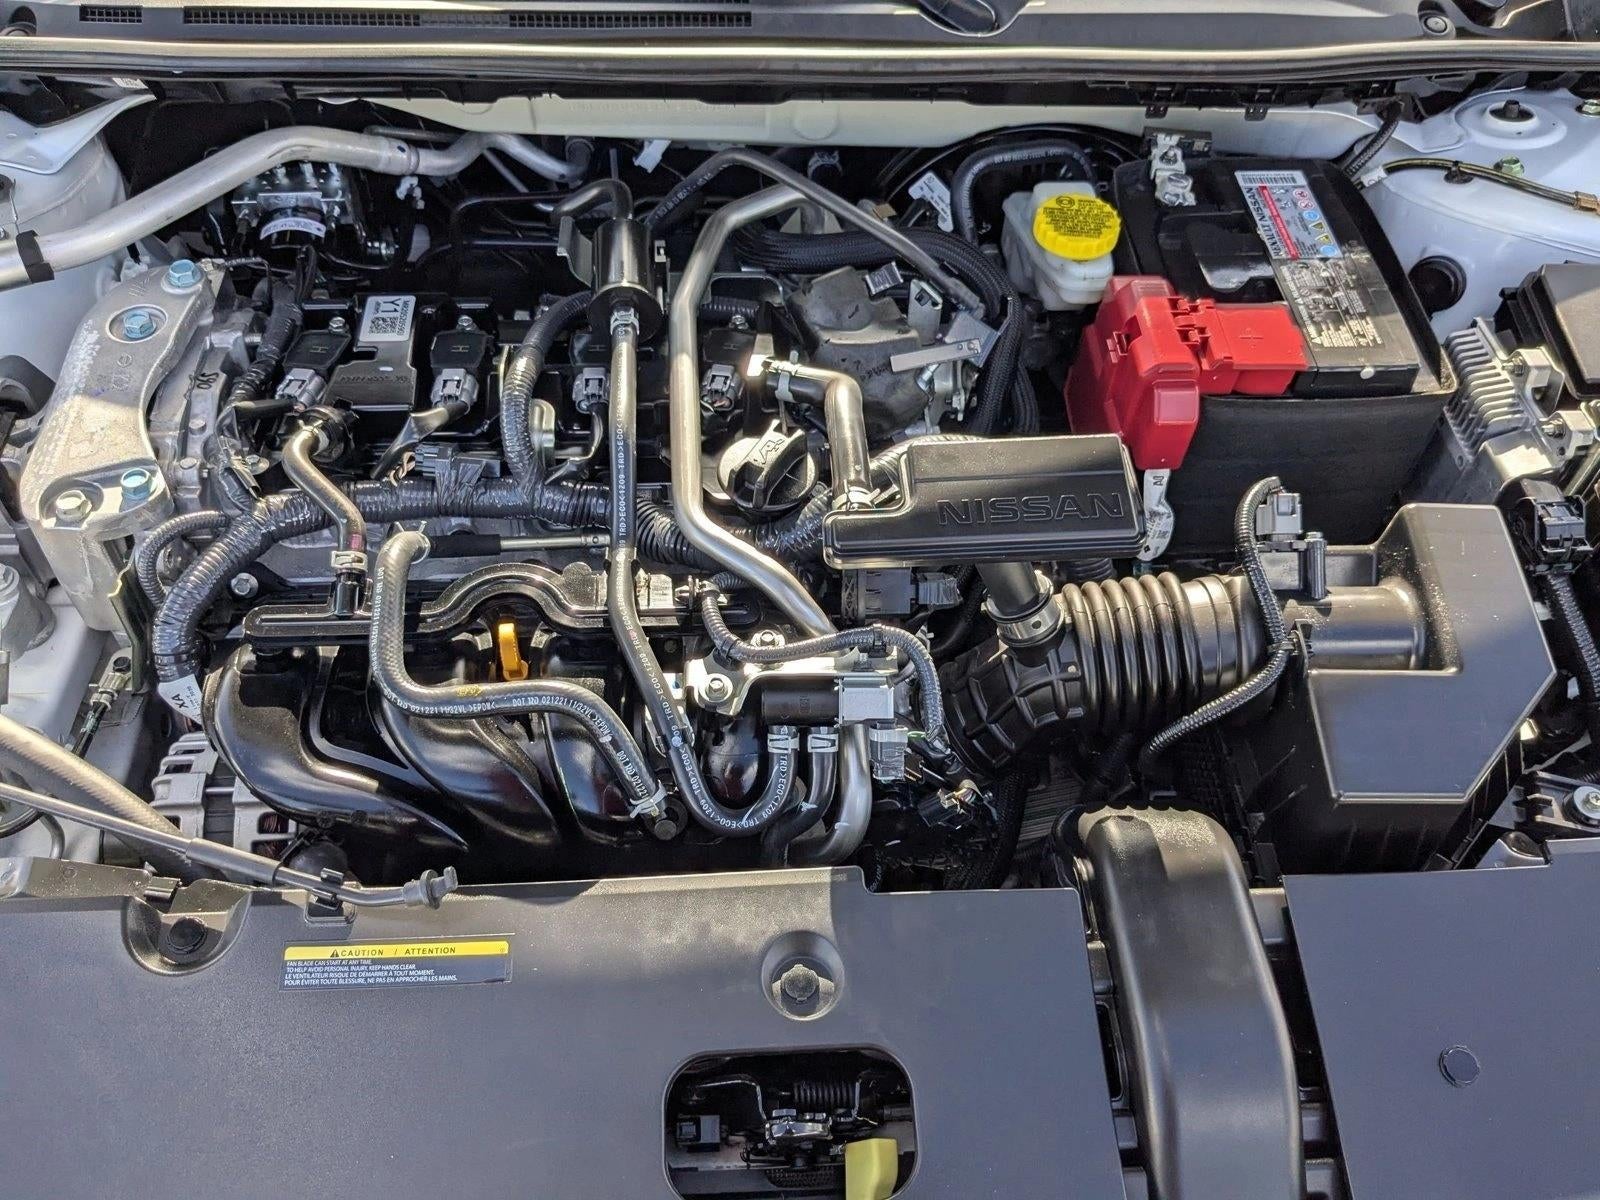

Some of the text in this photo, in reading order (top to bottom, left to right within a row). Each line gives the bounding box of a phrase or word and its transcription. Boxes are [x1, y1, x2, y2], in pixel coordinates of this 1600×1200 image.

[1244, 187, 1267, 222] NISSAN
[1261, 224, 1281, 257] RENAULT
[380, 297, 402, 313] Y1
[936, 492, 1124, 525] NISSAN
[541, 695, 568, 707] 021221
[341, 949, 384, 957] CAUTION
[404, 946, 456, 955] ATTENTION
[320, 977, 338, 985] TOUTE
